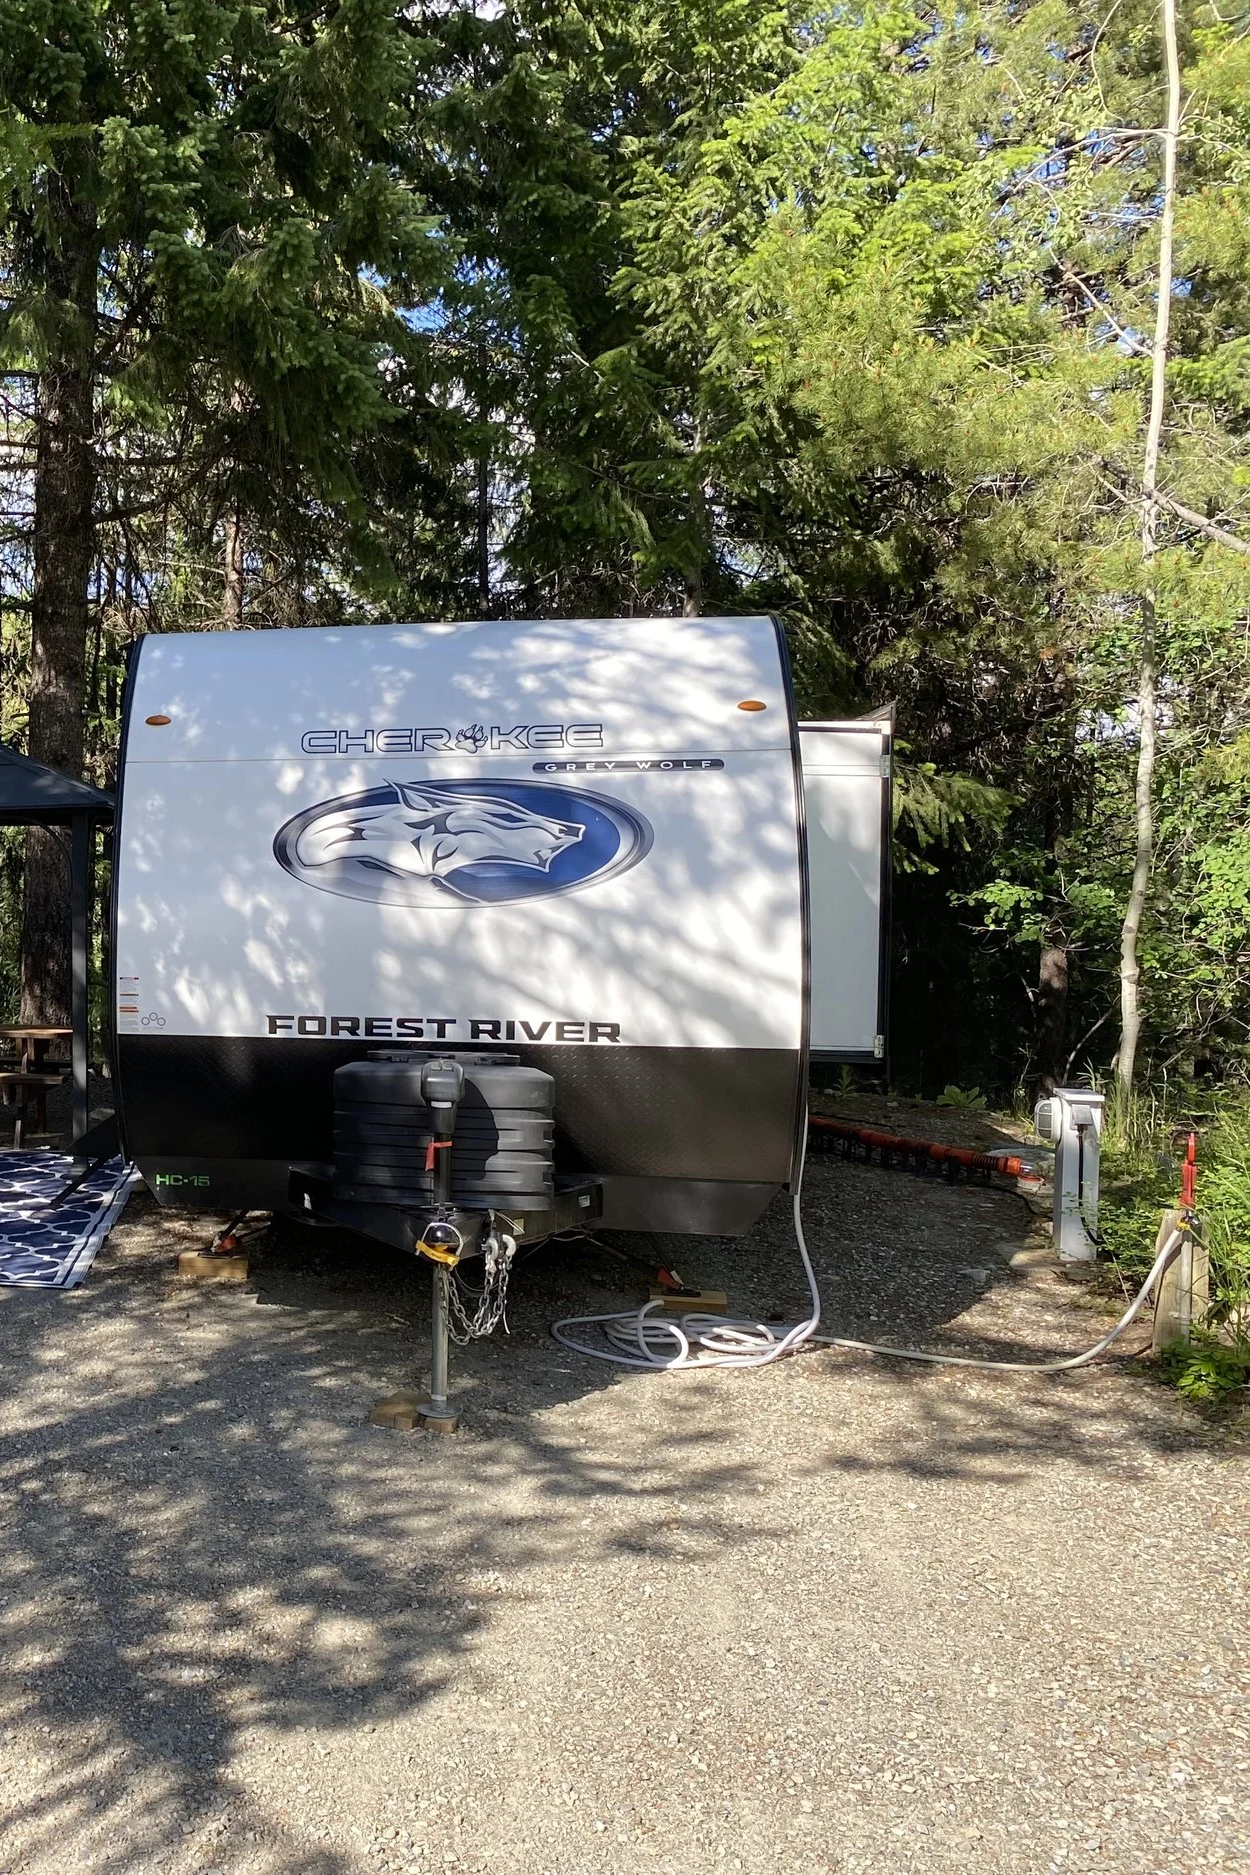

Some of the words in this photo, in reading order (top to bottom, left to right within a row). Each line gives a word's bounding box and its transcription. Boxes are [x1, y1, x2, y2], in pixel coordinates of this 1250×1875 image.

[544, 762, 616, 772] GREY
[636, 760, 712, 770] WOLF
[265, 1015, 457, 1039] FOREST
[468, 1019, 622, 1043] RIVER
[155, 1174, 211, 1187] HC-15
